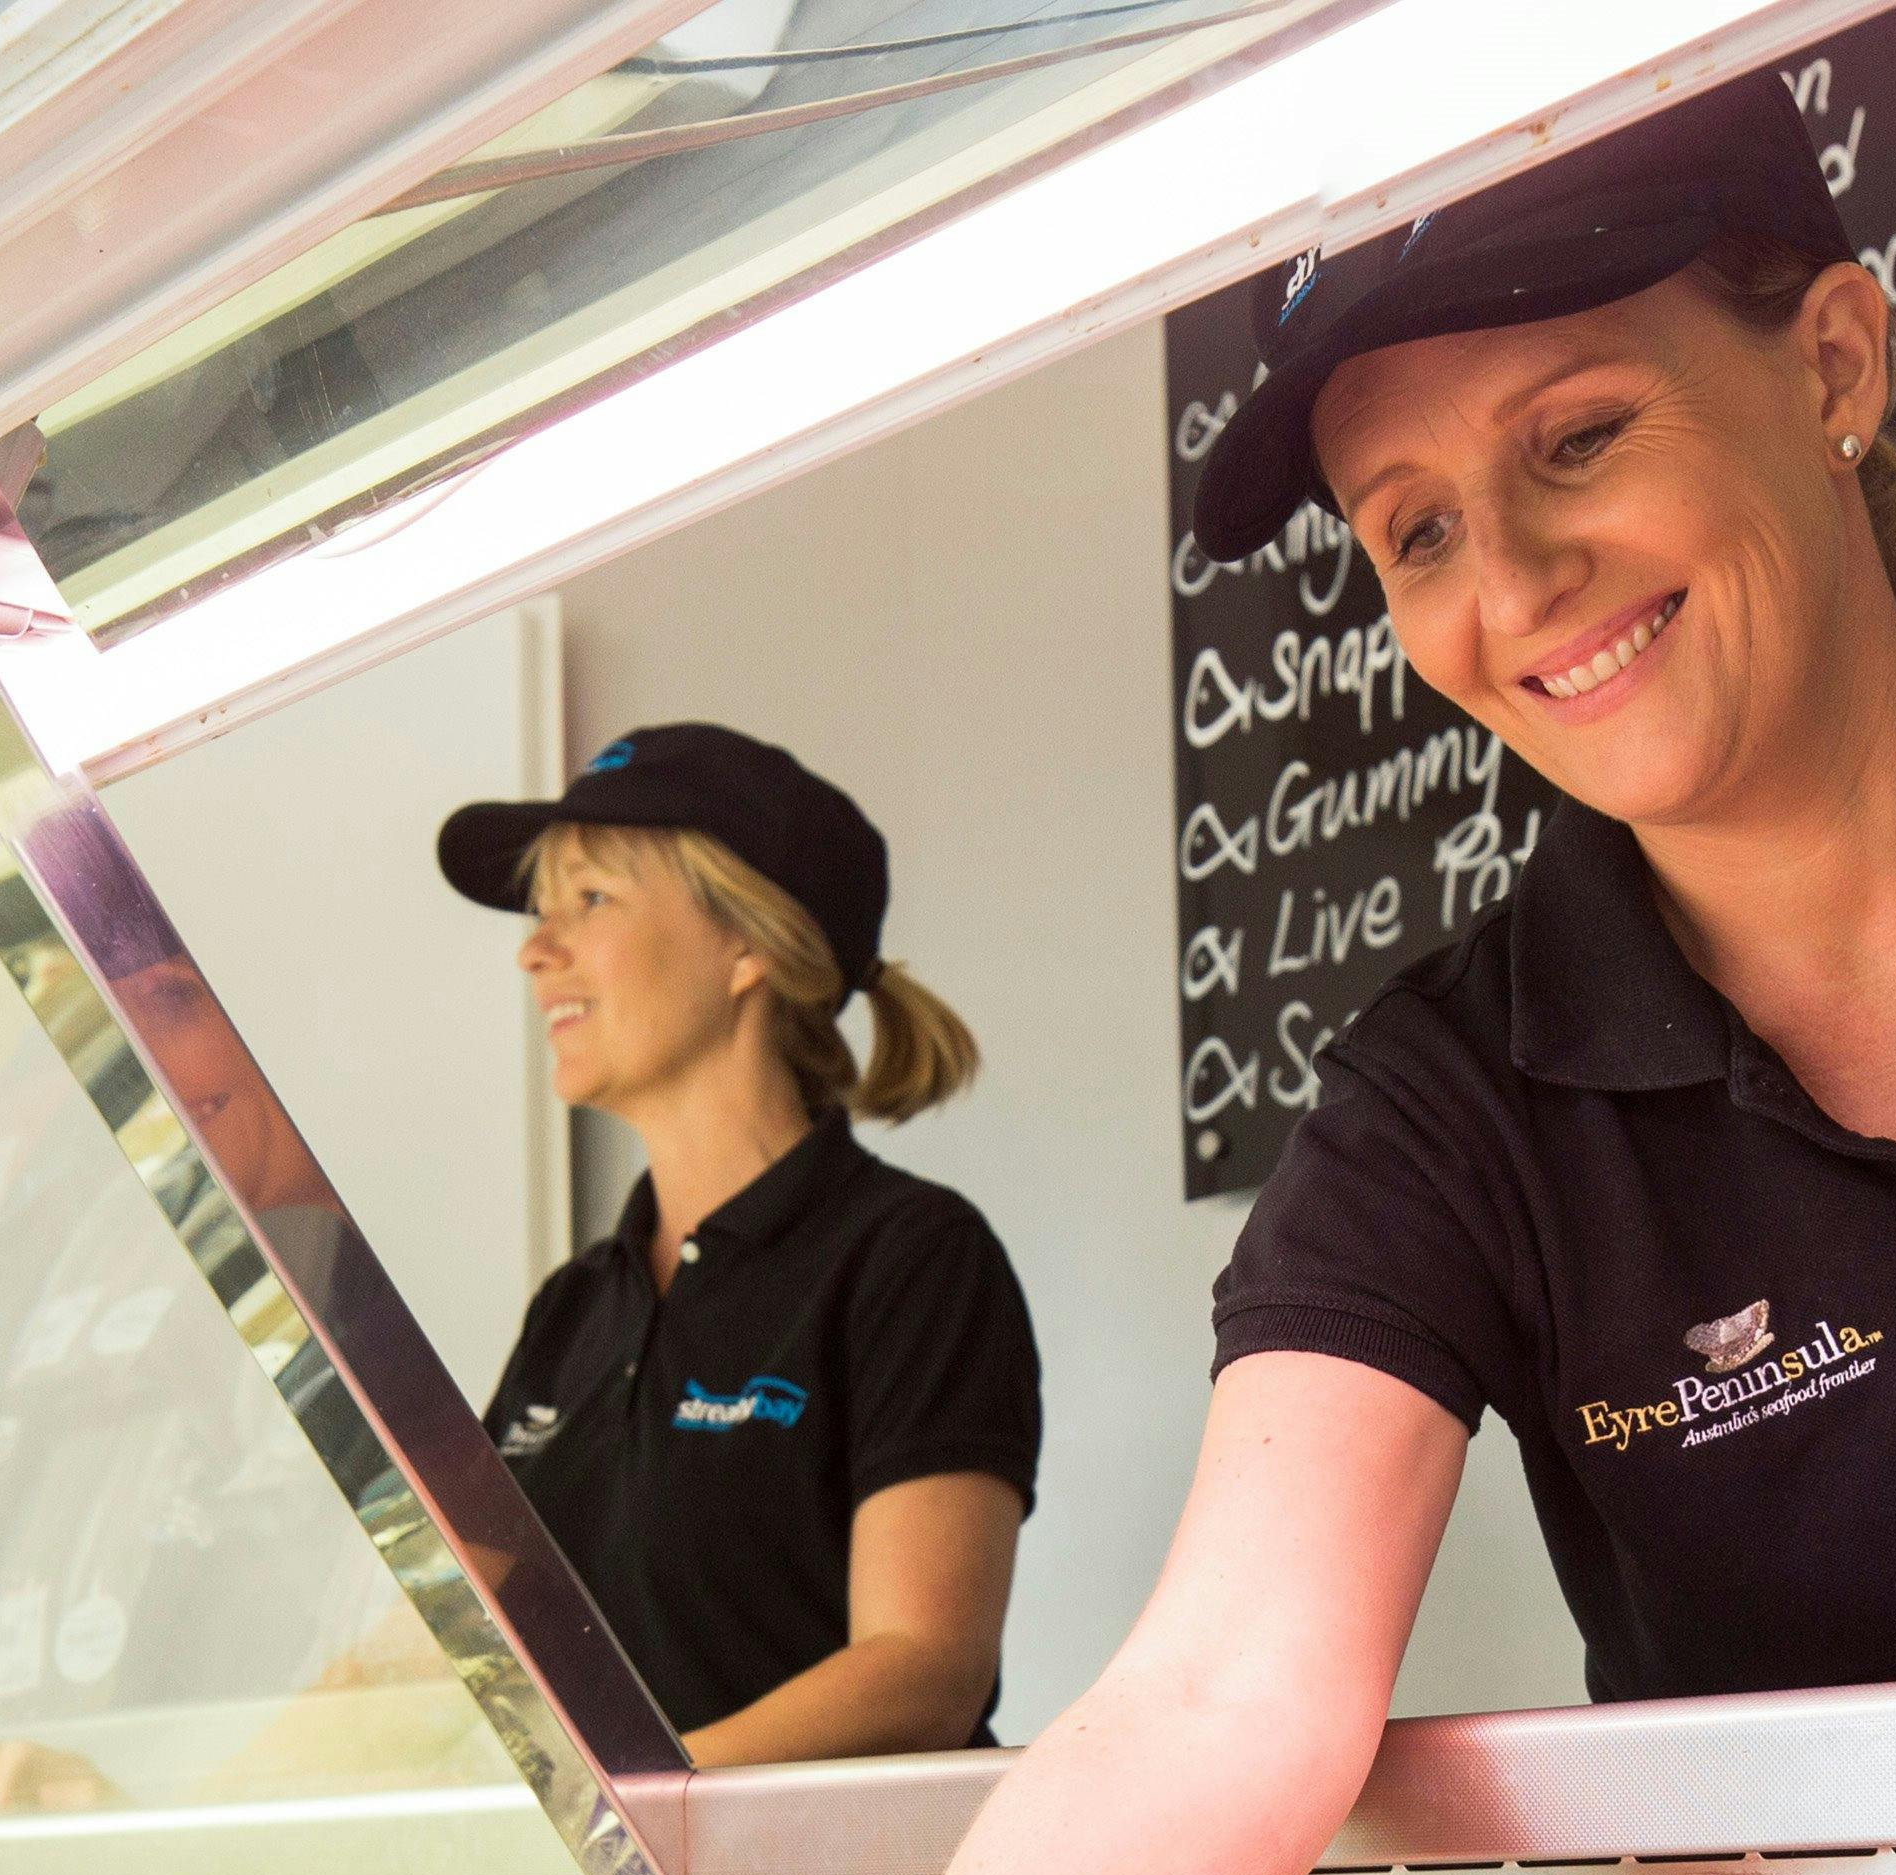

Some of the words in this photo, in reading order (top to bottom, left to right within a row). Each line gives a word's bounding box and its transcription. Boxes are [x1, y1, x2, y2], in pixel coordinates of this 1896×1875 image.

[1265, 725, 1503, 857] Gummy
[1268, 876, 1403, 978] Live
[1761, 1383, 1819, 1417] seafood
[1817, 1357, 1878, 1400] frontier
